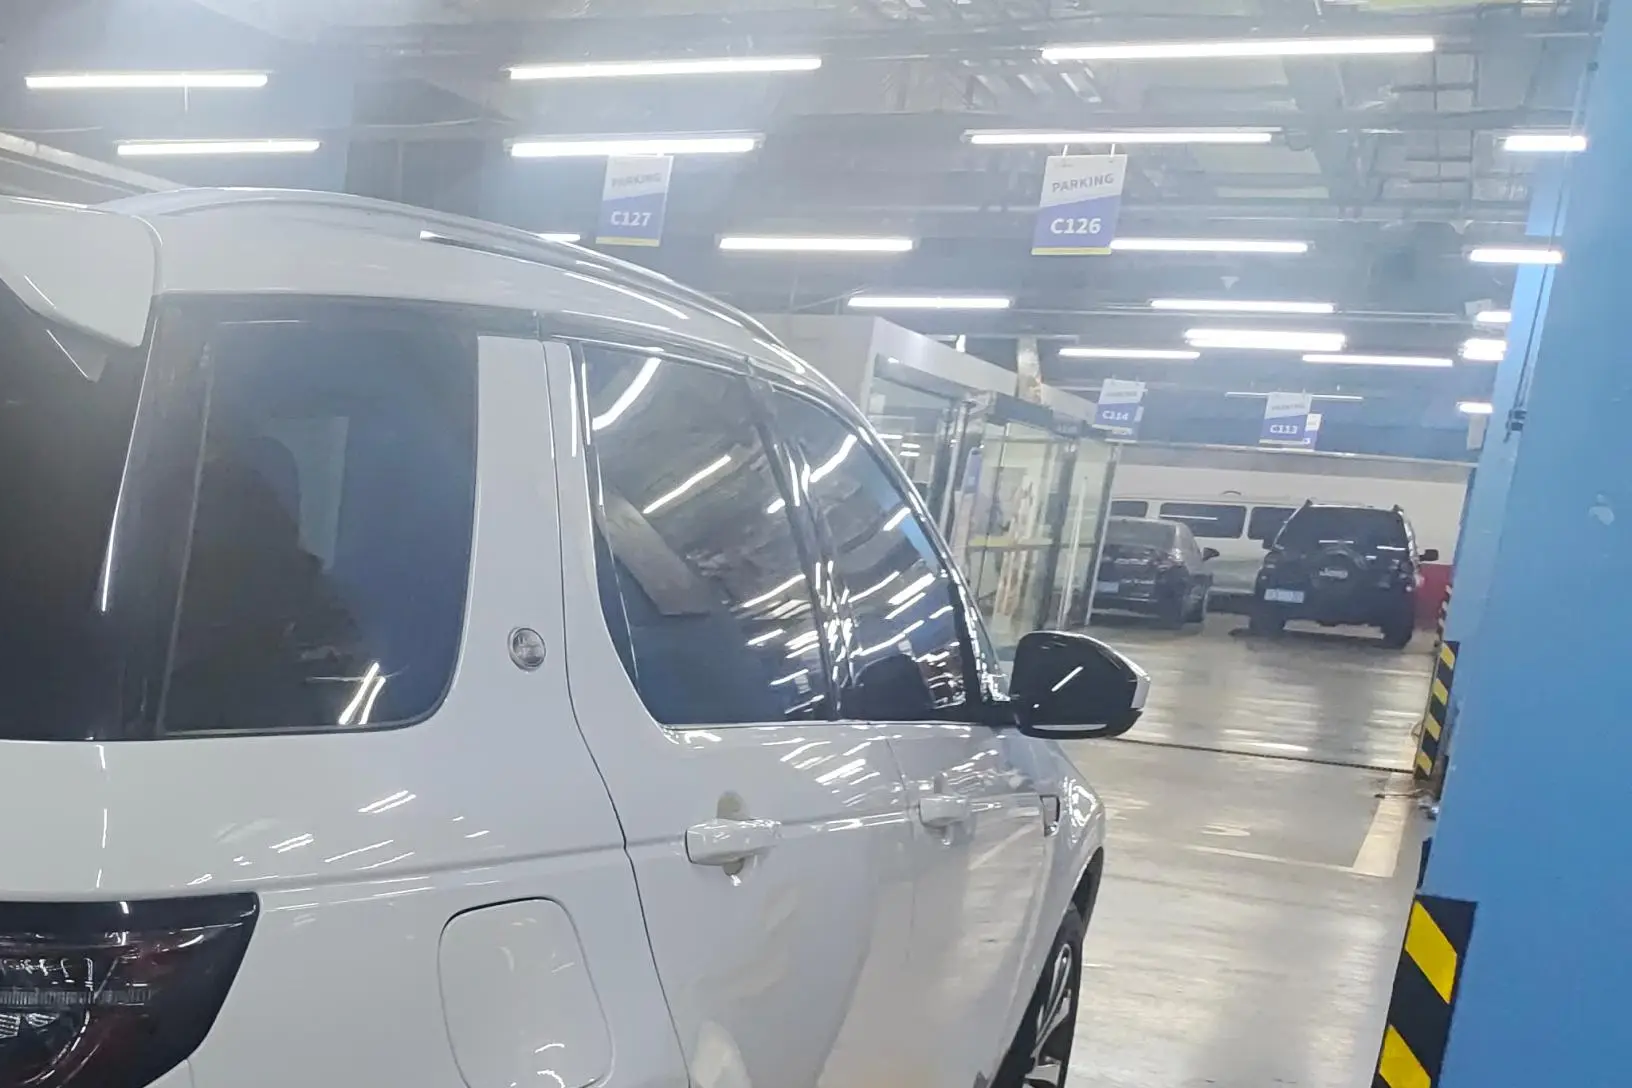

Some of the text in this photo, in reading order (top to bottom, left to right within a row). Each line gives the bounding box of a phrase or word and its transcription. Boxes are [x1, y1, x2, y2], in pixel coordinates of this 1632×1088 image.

[1051, 173, 1115, 193] PARKING
[610, 210, 652, 227] C127
[1050, 217, 1102, 235] C126
